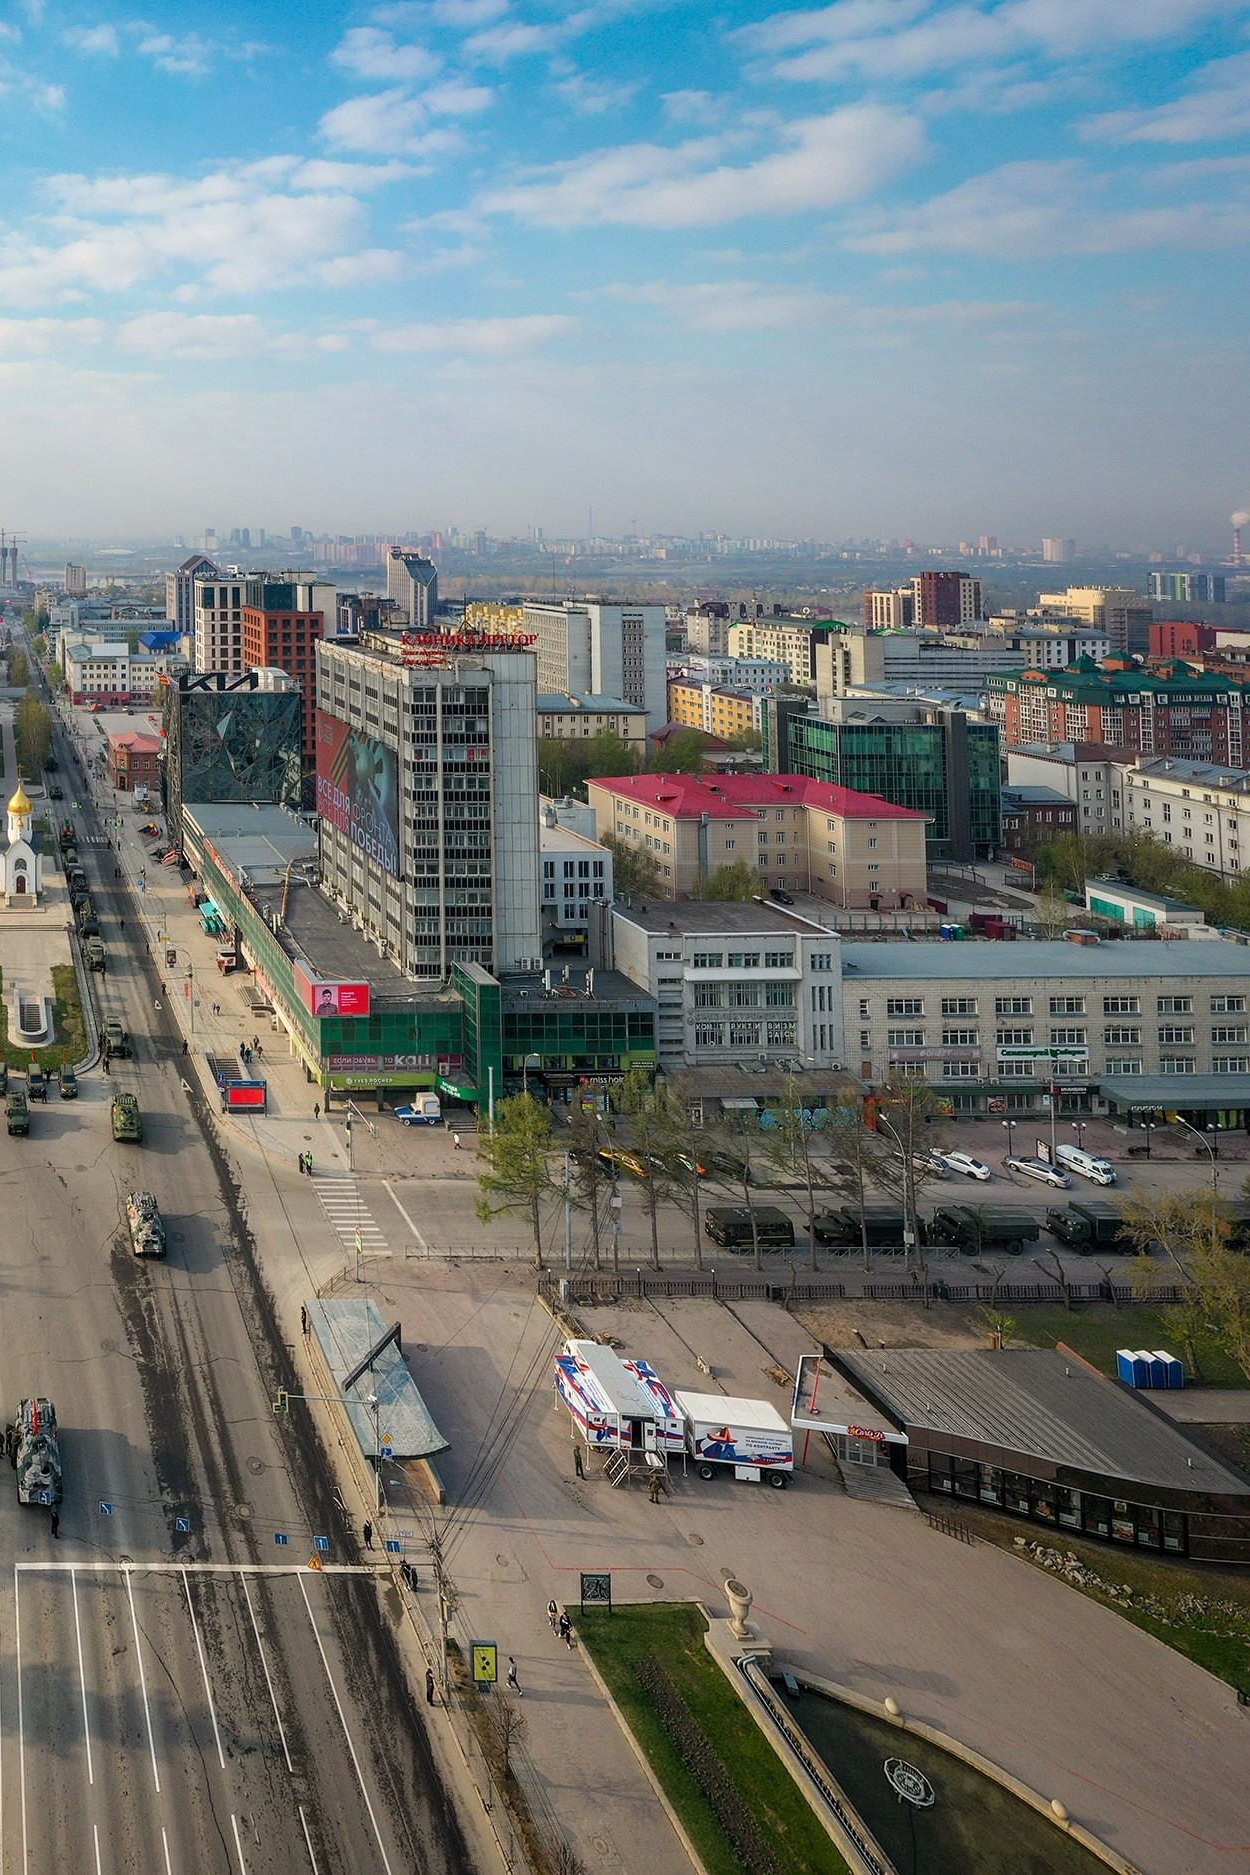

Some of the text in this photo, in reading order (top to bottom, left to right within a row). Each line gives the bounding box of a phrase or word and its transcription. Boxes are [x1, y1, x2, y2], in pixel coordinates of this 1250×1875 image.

[401, 634, 476, 645] КЛИНИКА
[179, 673, 258, 691] KIA
[333, 787, 351, 815] ДЛЯ
[333, 808, 350, 835] ДЛЯ
[350, 821, 397, 876] ПОБЕДЫ!
[395, 1054, 430, 1065] kari
